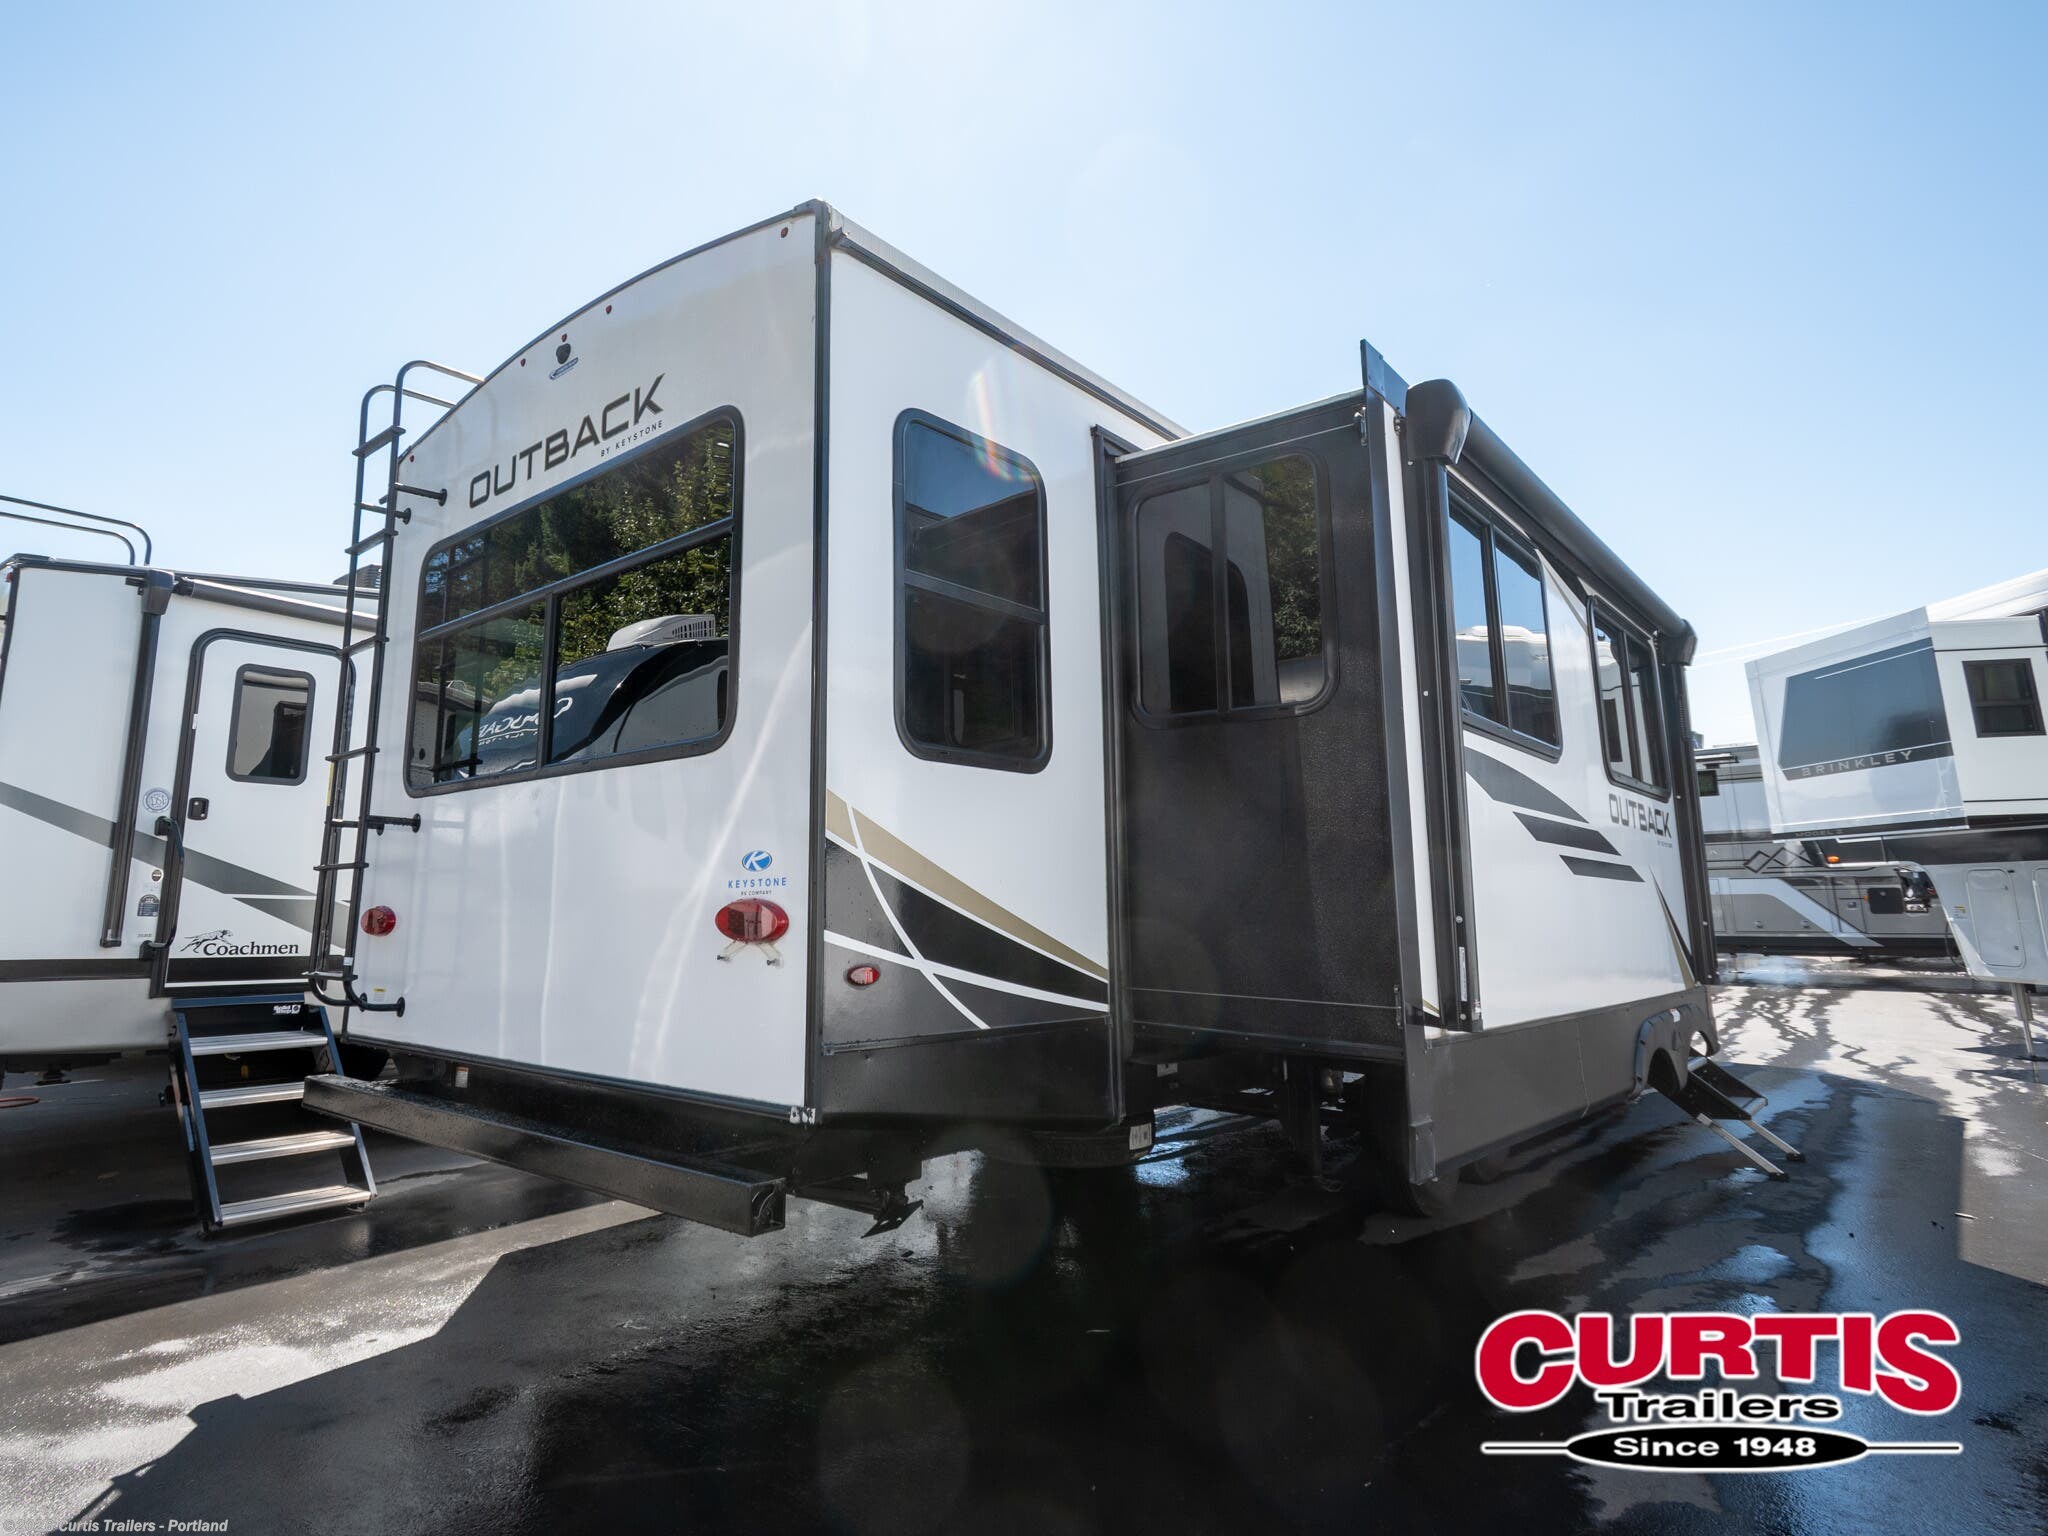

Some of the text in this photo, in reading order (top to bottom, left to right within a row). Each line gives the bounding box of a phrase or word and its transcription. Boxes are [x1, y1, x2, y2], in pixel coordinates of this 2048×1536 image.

[469, 373, 666, 509] OUTBACK
[600, 420, 664, 457] BY KEYSTONE
[1801, 750, 1913, 777] BRINKLEY
[1609, 793, 1672, 839] OUTBACK
[727, 877, 787, 889] KEYSTONE
[203, 941, 299, 956] Coachmen
